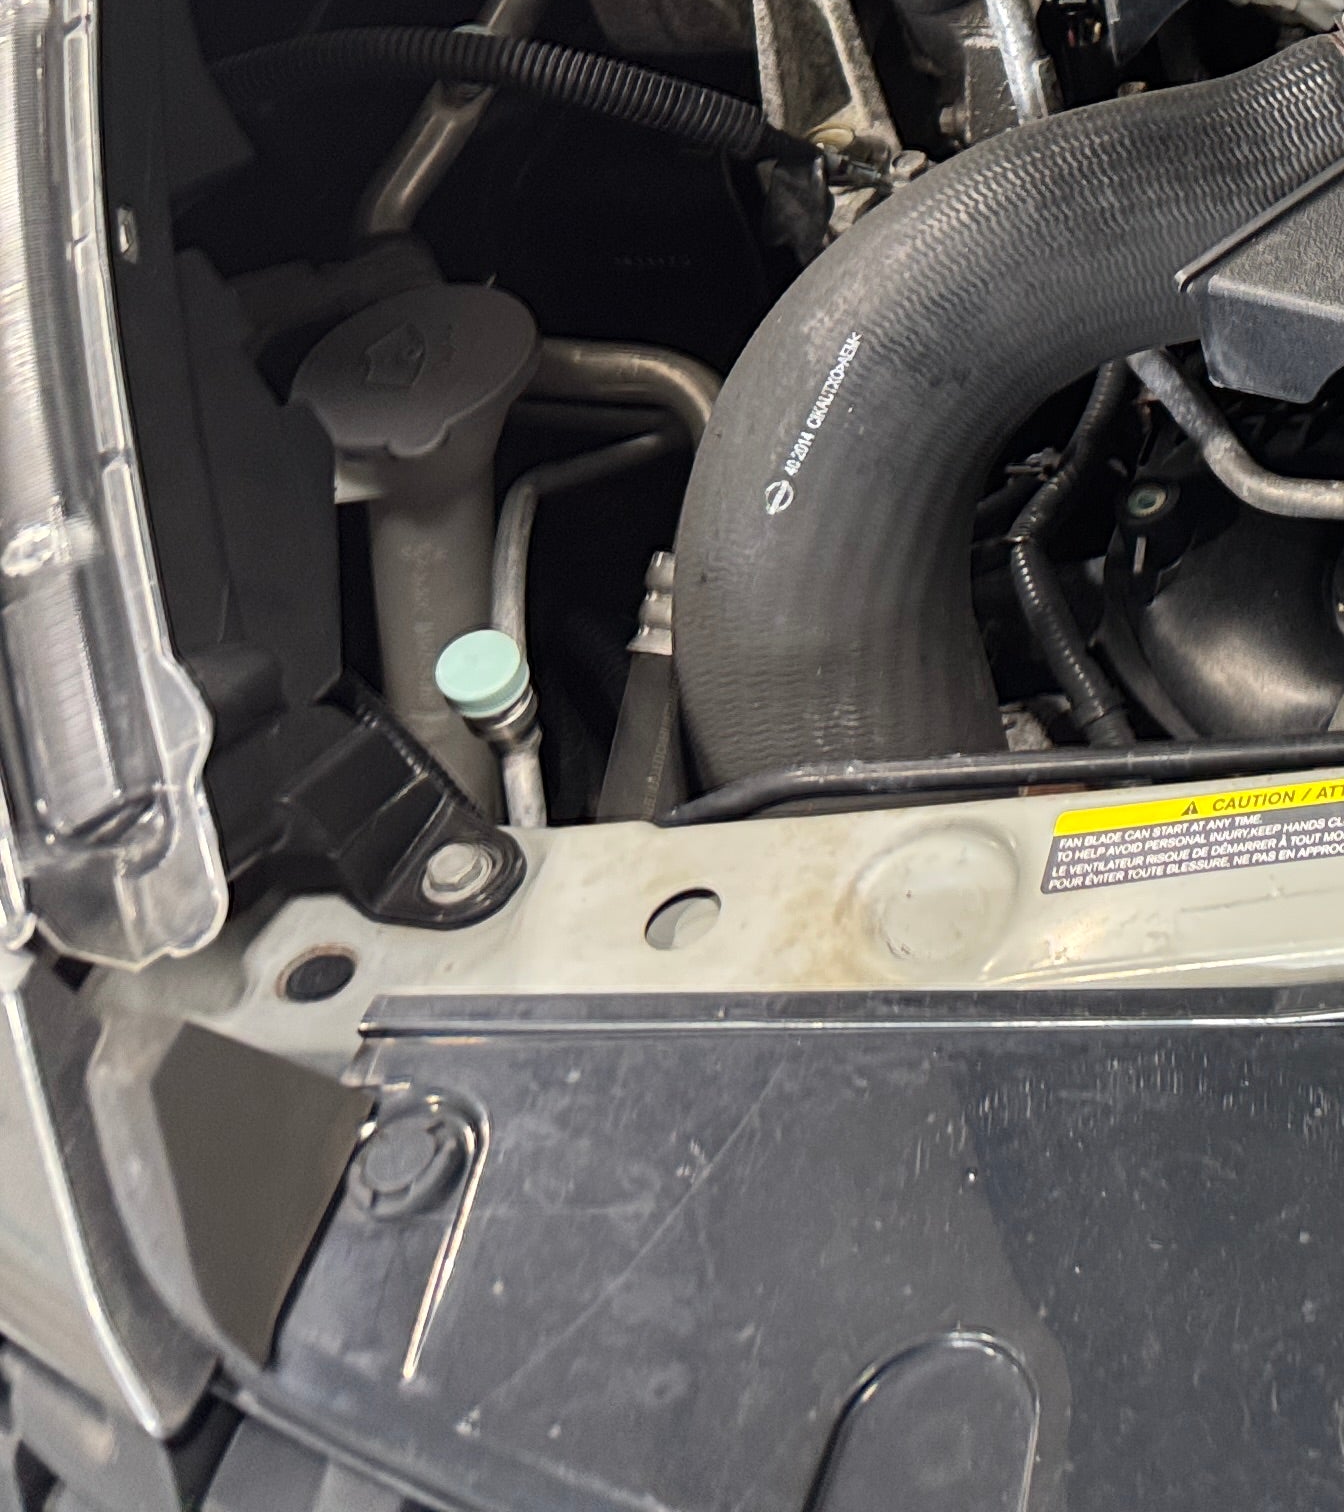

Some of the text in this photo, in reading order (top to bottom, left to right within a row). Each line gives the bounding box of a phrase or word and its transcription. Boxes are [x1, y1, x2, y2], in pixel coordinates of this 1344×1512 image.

[1212, 789, 1296, 812] CAUTION
[1301, 788, 1312, 802] /
[1057, 851, 1072, 862] TO
[1074, 847, 1105, 860] HELP
[1106, 842, 1143, 856] AVOID
[1145, 834, 1206, 850] PERSONAL
[1283, 818, 1325, 833] HANDS
[1059, 813, 1263, 849] FAN BLADE CAN START AT ANY TIME.
[1048, 876, 1083, 890] POUR
[1085, 870, 1125, 886] ÉVITER
[1127, 867, 1164, 880] TOUTE
[1233, 854, 1250, 866] NE
[1252, 851, 1276, 863] PAS
[1278, 848, 1295, 860] EN
[1052, 866, 1067, 877] LE
[1069, 857, 1144, 875] VENTILATEUR
[1146, 850, 1189, 865] RISQUE
[1192, 847, 1209, 858] DE
[1211, 839, 1276, 856] DÉMARRER
[1278, 834, 1287, 847] À
[1290, 833, 1321, 846] TOUT
